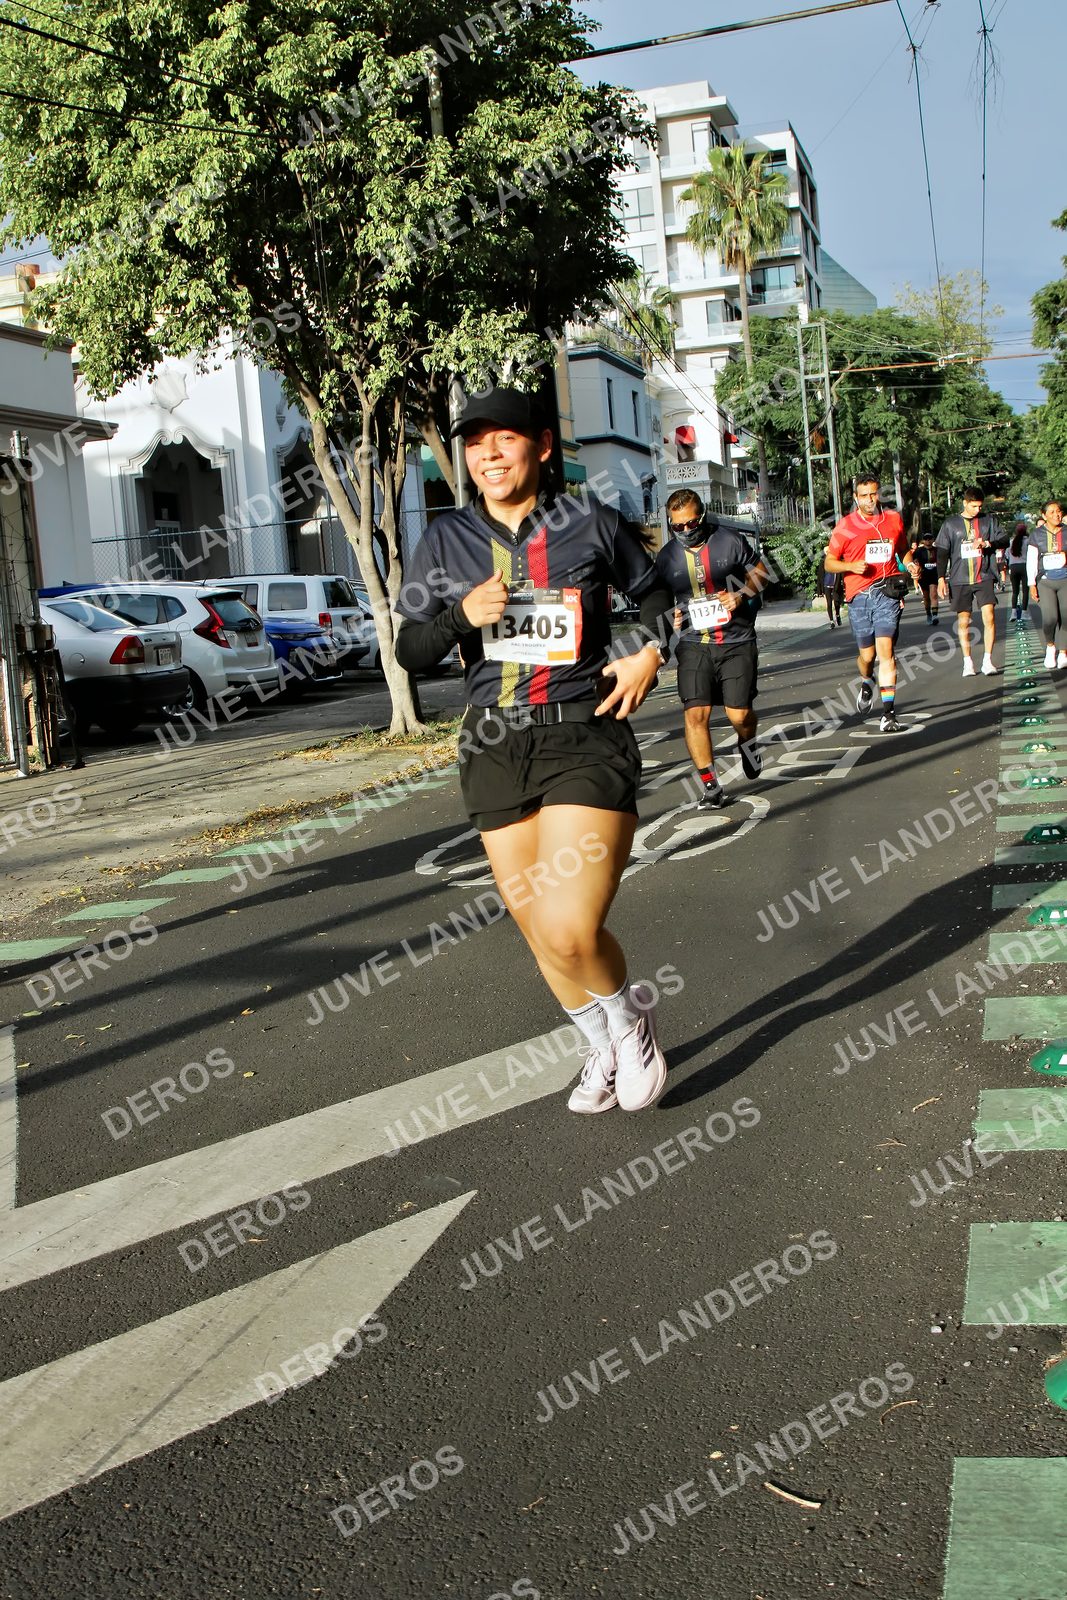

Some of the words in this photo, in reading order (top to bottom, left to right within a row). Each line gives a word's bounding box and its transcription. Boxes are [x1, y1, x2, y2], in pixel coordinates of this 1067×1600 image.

[869, 546, 888, 554] 8236
[691, 605, 724, 618] 11374
[490, 614, 568, 639] 13405
